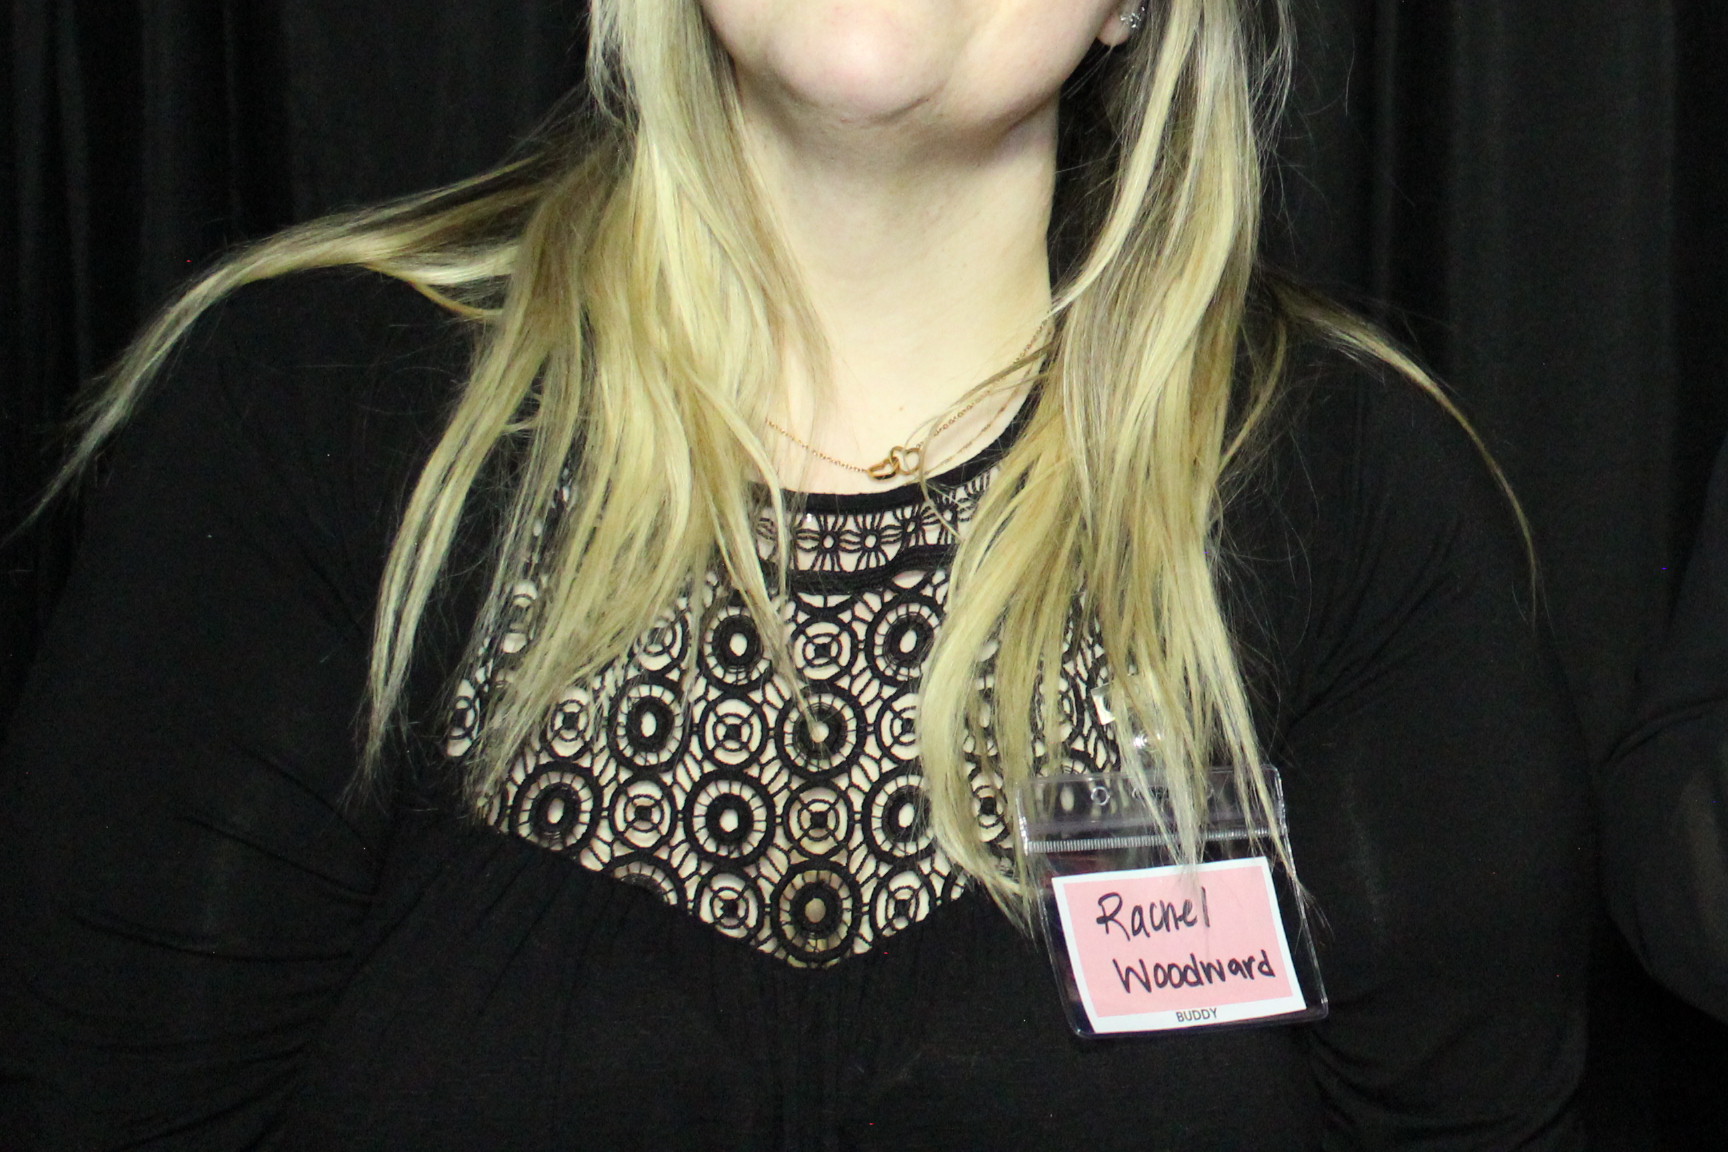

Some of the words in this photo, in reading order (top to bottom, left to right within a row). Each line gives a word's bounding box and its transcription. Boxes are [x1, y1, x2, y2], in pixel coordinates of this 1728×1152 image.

[1096, 886, 1210, 941] Rachel
[1112, 949, 1275, 993] Woodward
[1175, 1007, 1218, 1023] BUDDY
